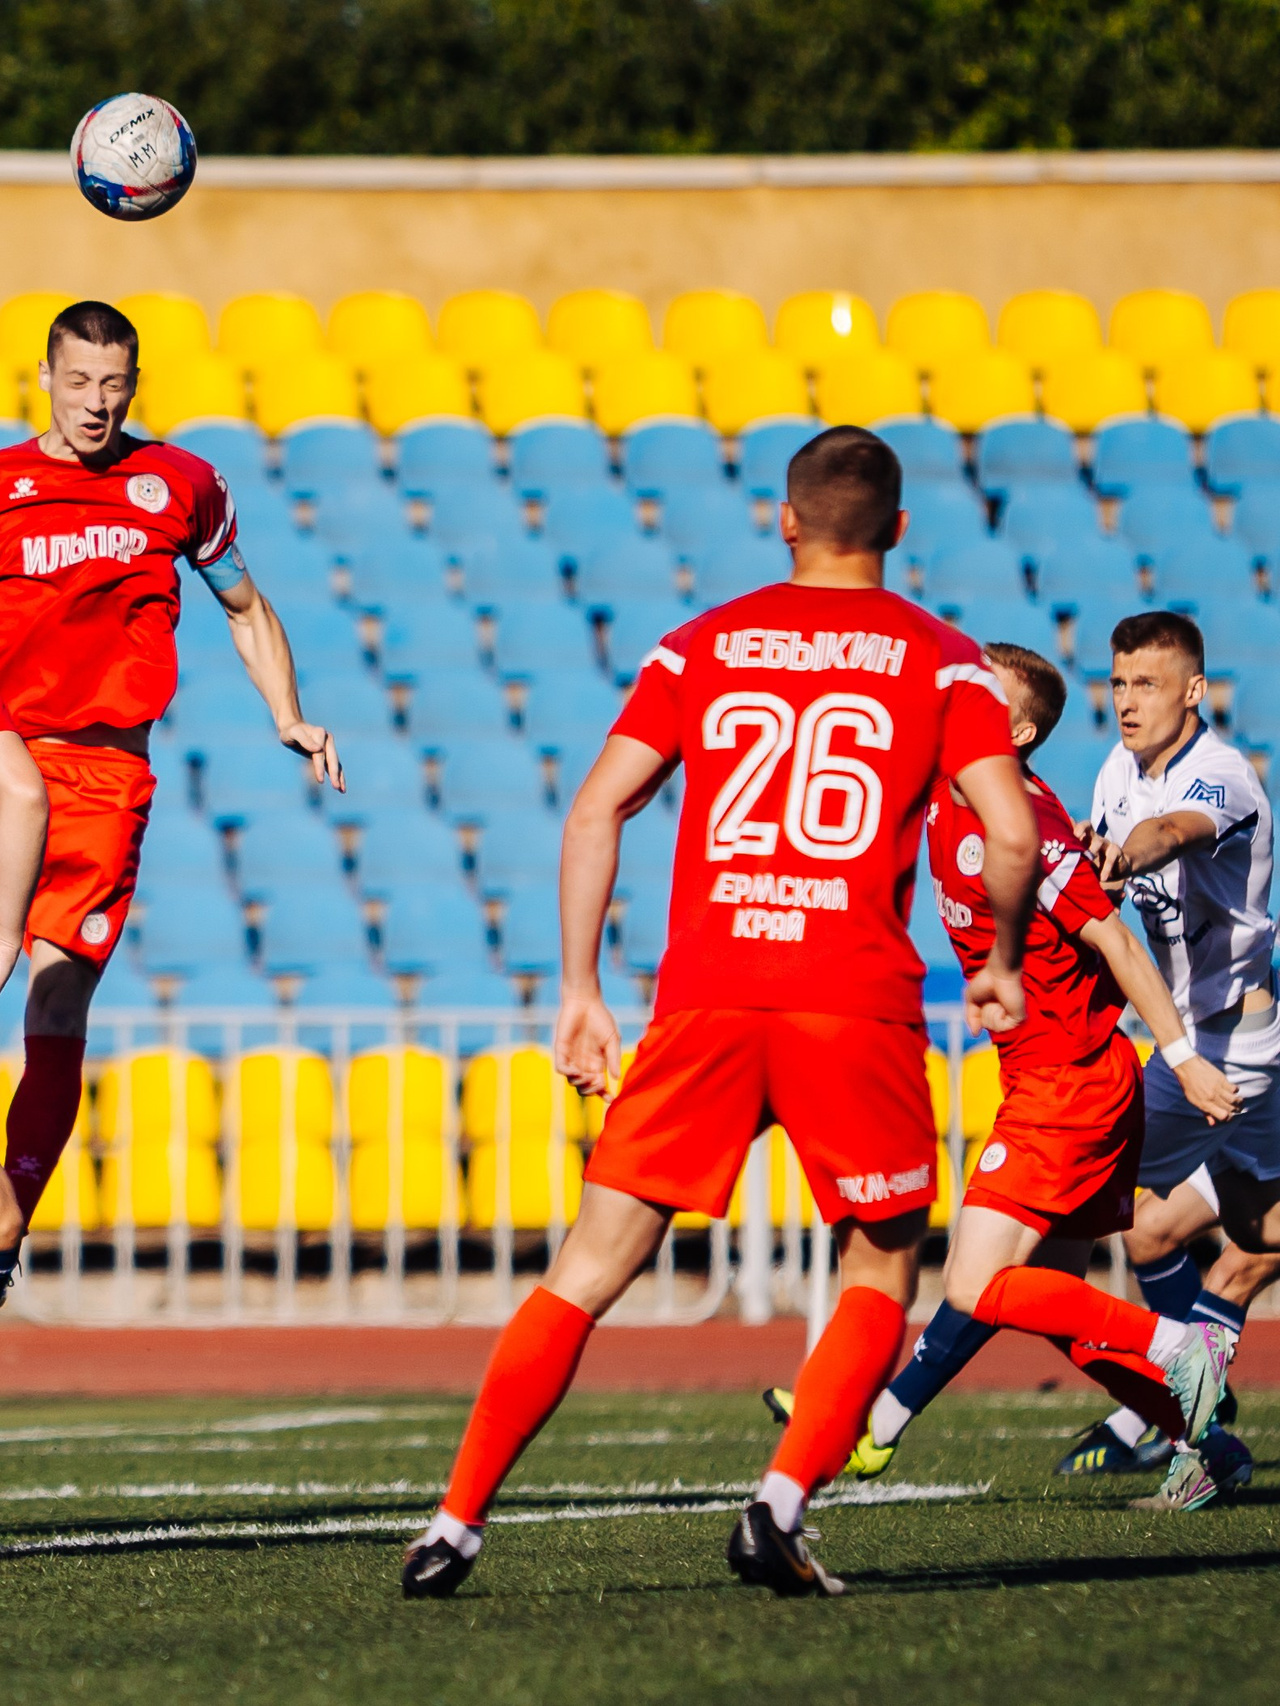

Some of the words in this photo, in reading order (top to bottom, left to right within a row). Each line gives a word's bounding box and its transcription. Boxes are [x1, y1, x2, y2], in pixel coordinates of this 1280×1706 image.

[109, 108, 155, 144] DEMIX
[22, 525, 148, 576] ИЛЬПАР
[714, 628, 907, 677] ЧЕБЫКИН
[702, 691, 894, 862] 26
[710, 871, 849, 911] ЕРМСКИЙ
[732, 908, 806, 942] КРАЙ
